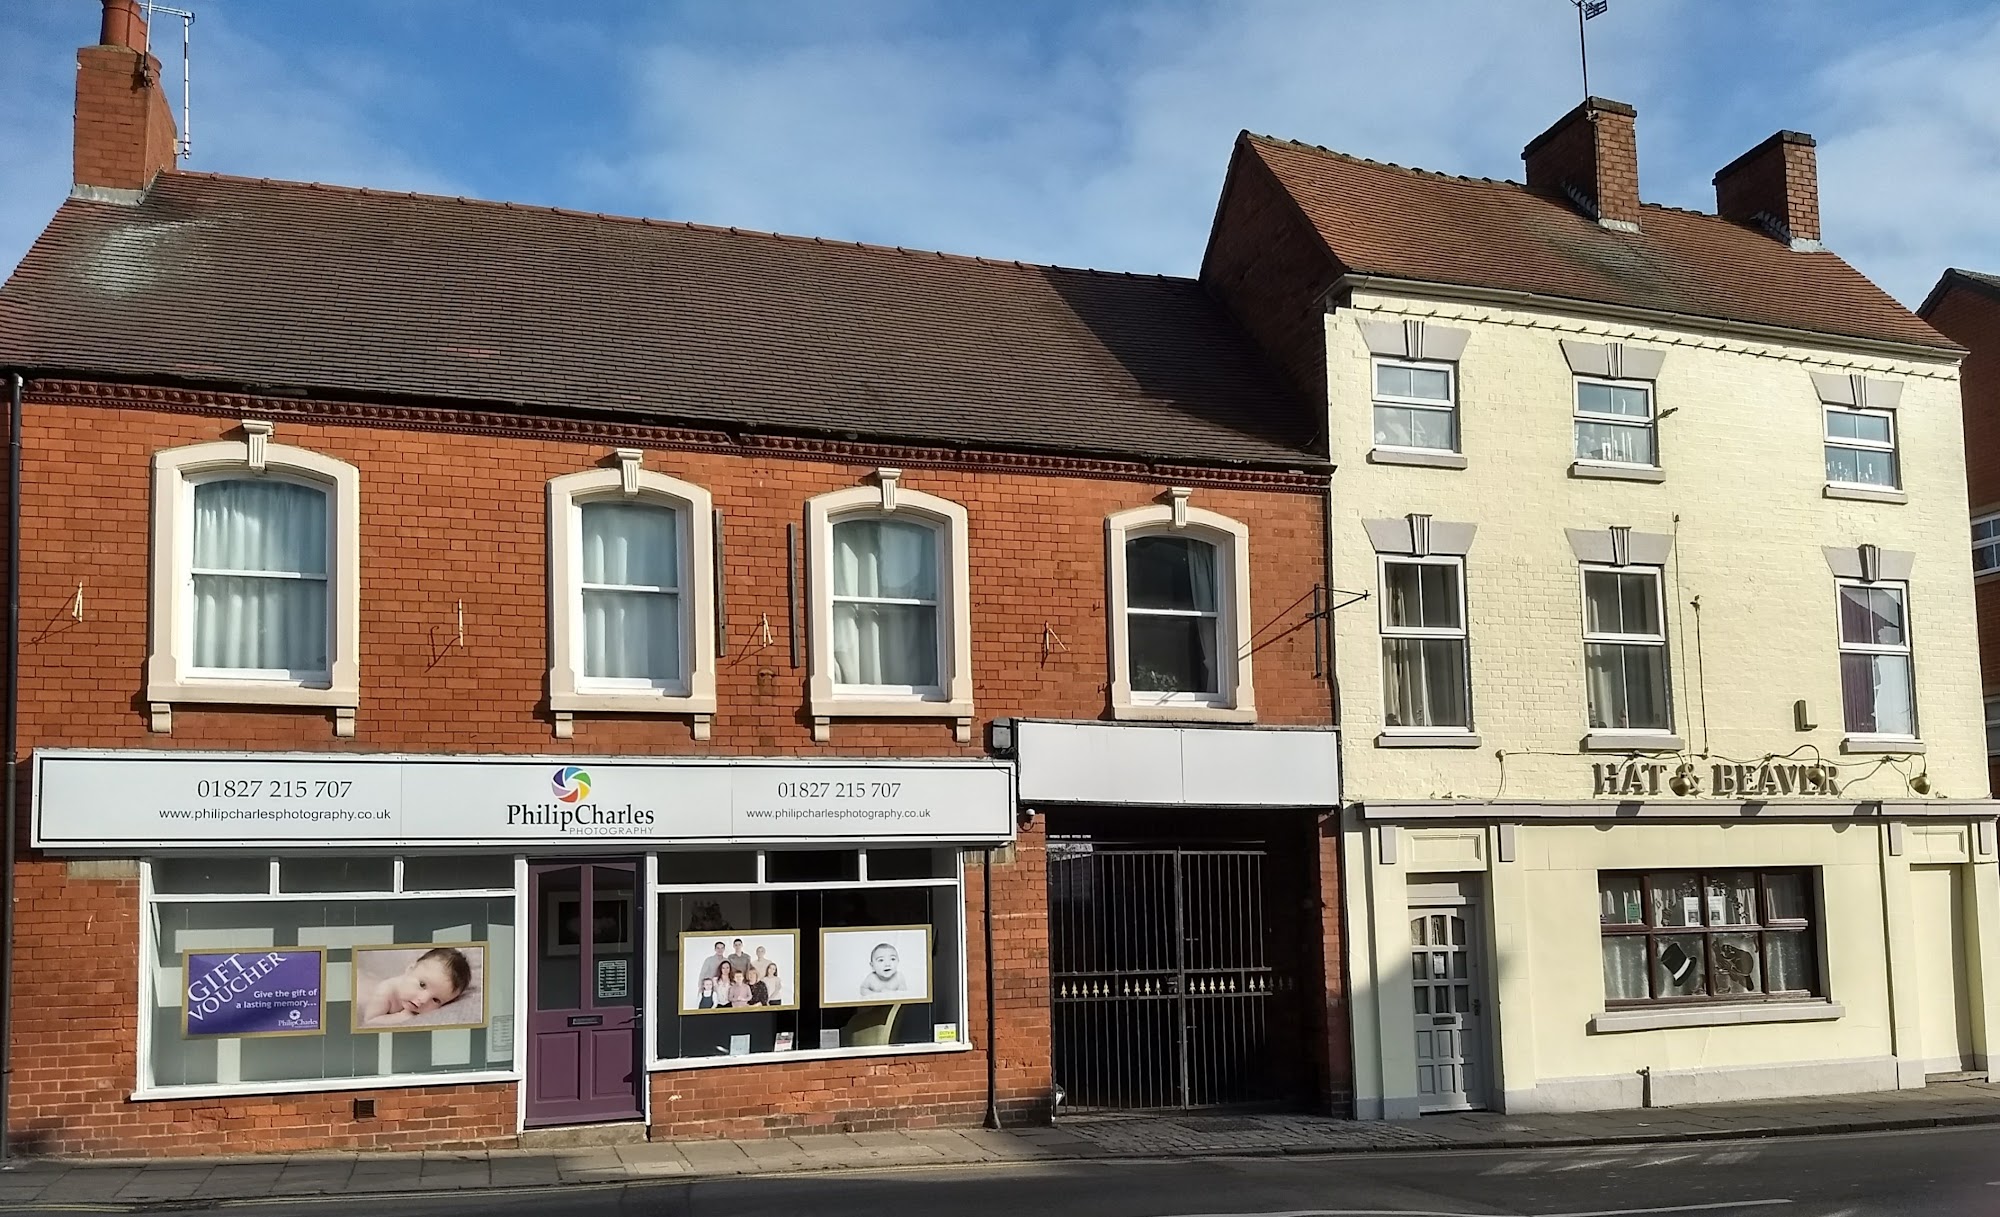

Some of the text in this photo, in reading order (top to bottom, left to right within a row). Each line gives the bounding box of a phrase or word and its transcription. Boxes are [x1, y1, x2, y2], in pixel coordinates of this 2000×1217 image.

[1593, 763, 1667, 795] HAT
[1676, 763, 1705, 795] &
[197, 780, 353, 798] 01827 215 707
[777, 782, 901, 798] 01827 215 707
[158, 808, 391, 821] www.philipcharlesphotography.co.uk
[746, 808, 931, 820] www.philipcharlesphotography.co.uk
[569, 826, 654, 835] PHOTOGRAPHY
[187, 953, 246, 1002] GIFT
[187, 952, 287, 1021] VOUCHER
[253, 988, 318, 998] Give the gift of
[243, 1001, 272, 1009] lasting
[273, 1000, 317, 1008] memory...
